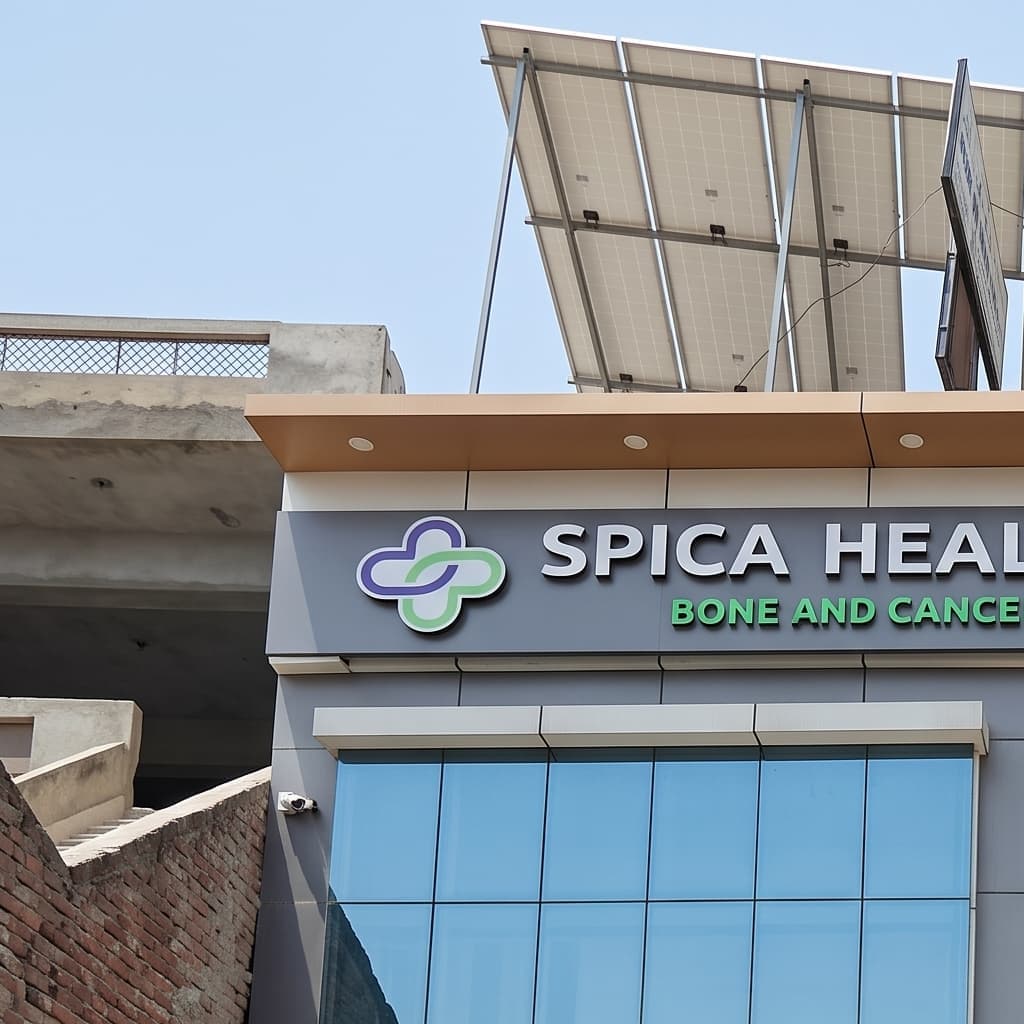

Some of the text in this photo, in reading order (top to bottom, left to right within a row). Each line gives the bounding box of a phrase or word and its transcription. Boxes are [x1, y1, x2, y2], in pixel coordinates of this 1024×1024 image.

[541, 524, 789, 576] SPICA
[672, 598, 776, 624] BONE
[793, 598, 875, 623] AND
